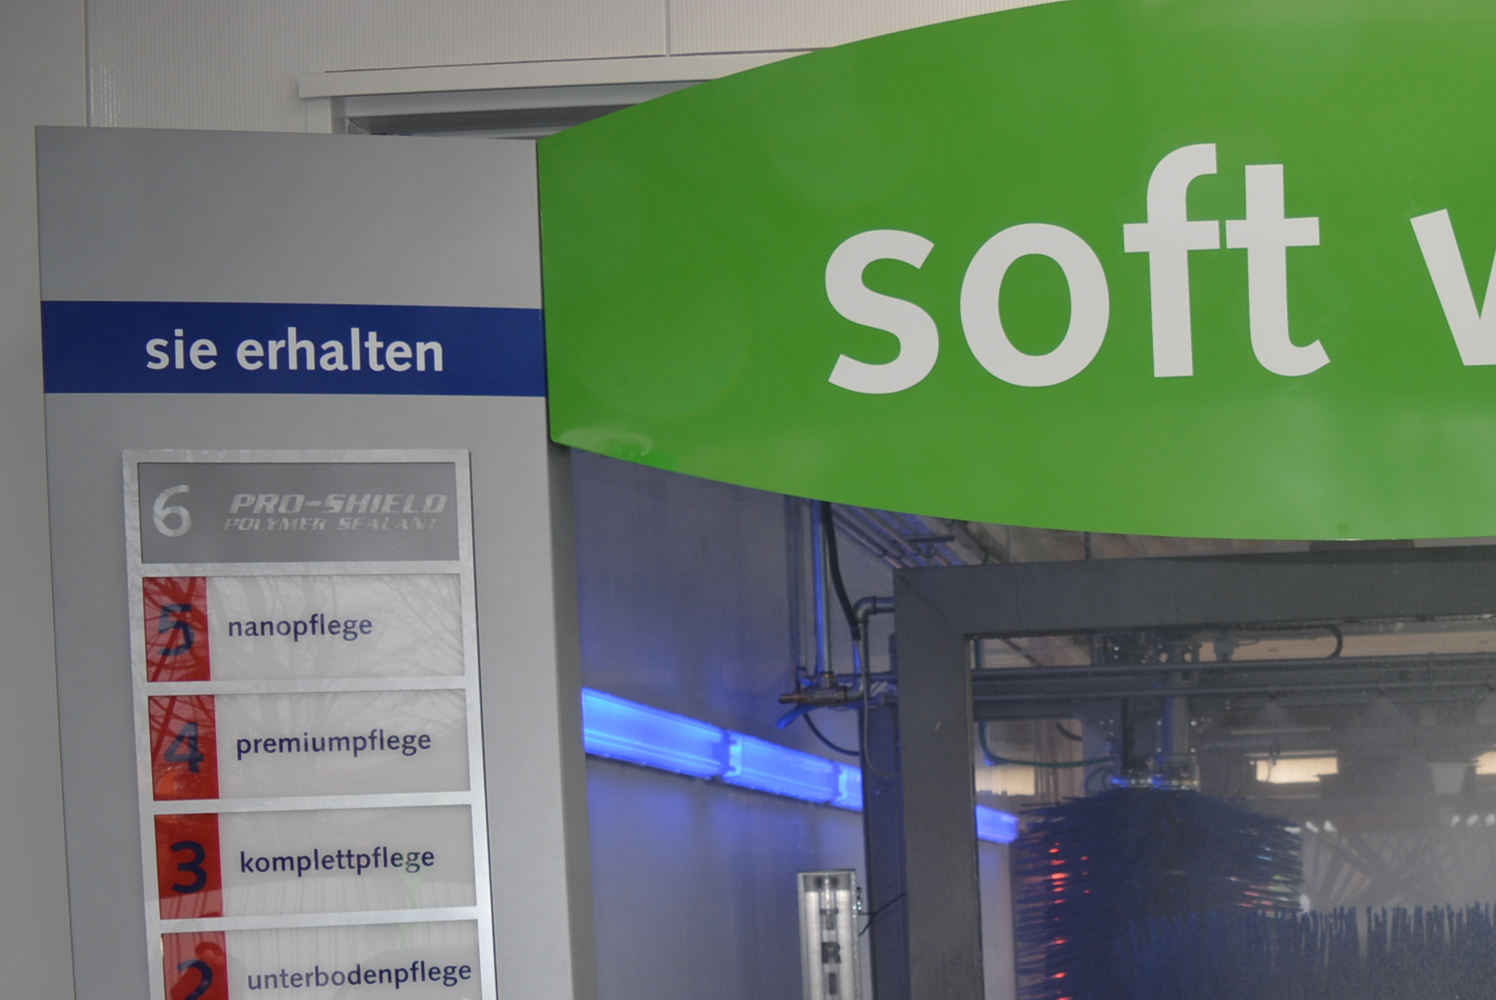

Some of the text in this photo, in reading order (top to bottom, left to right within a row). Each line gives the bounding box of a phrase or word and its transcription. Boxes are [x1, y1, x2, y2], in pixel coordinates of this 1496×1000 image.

[823, 142, 1331, 395] soft
[145, 326, 444, 372] sie erhalten
[153, 484, 192, 538] 6
[223, 516, 438, 531] POLYMER SEALANT
[228, 493, 448, 514] PRO-SHIELD
[156, 602, 373, 657] 5 nanopflege
[162, 722, 432, 773] 4 premiumpflege
[170, 841, 436, 894] 3 komplettpflege
[246, 959, 472, 991] unterbodenpflege
